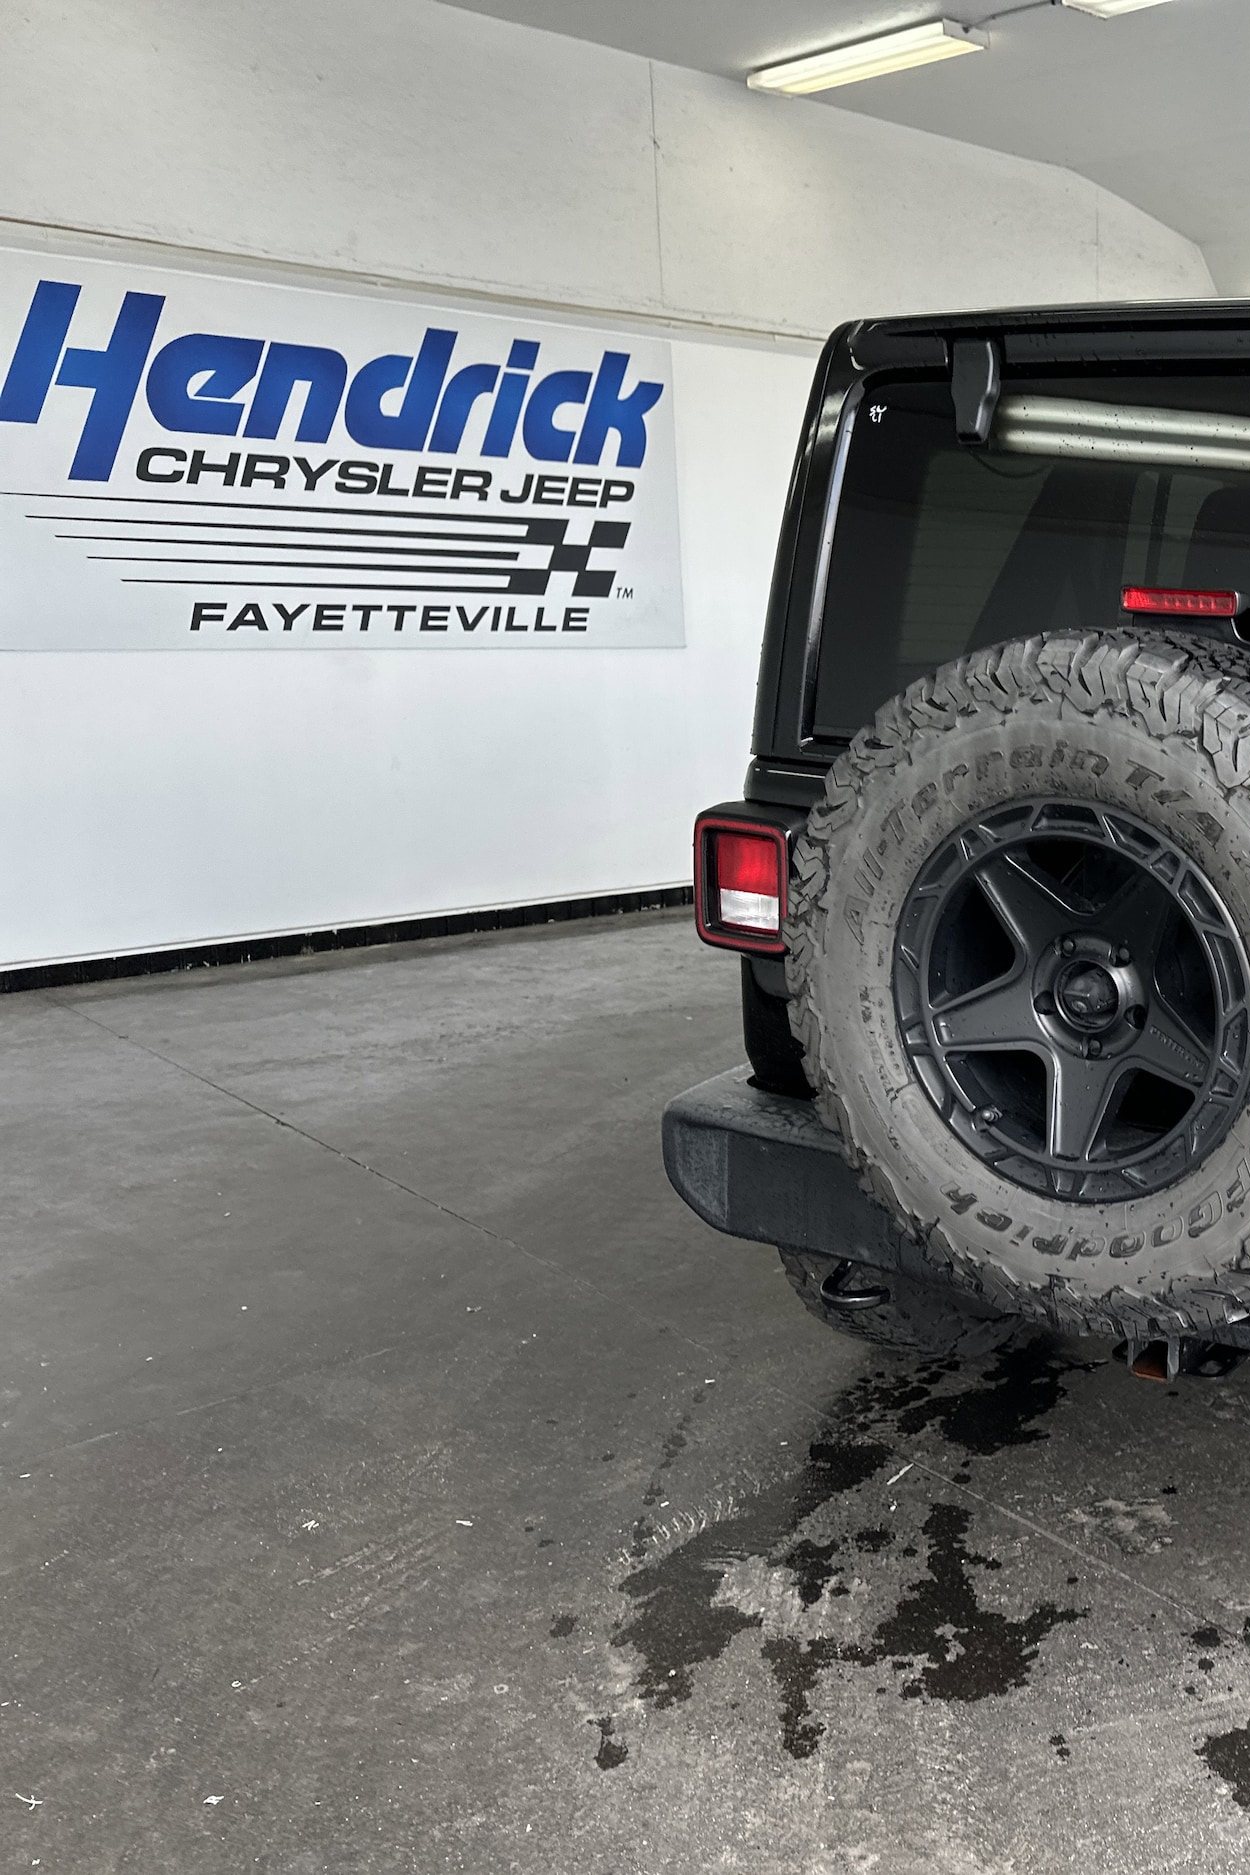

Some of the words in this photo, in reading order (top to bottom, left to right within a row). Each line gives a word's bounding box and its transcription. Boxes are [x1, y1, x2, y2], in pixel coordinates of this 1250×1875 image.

[0, 280, 664, 482] Hendrick
[136, 447, 488, 502] CHRYSLER
[499, 473, 635, 508] JEEP
[189, 602, 590, 632] FAYETTEVILLE
[616, 587, 634, 599] TM
[843, 739, 1110, 946] All-Terrain
[1125, 758, 1226, 850] T/A
